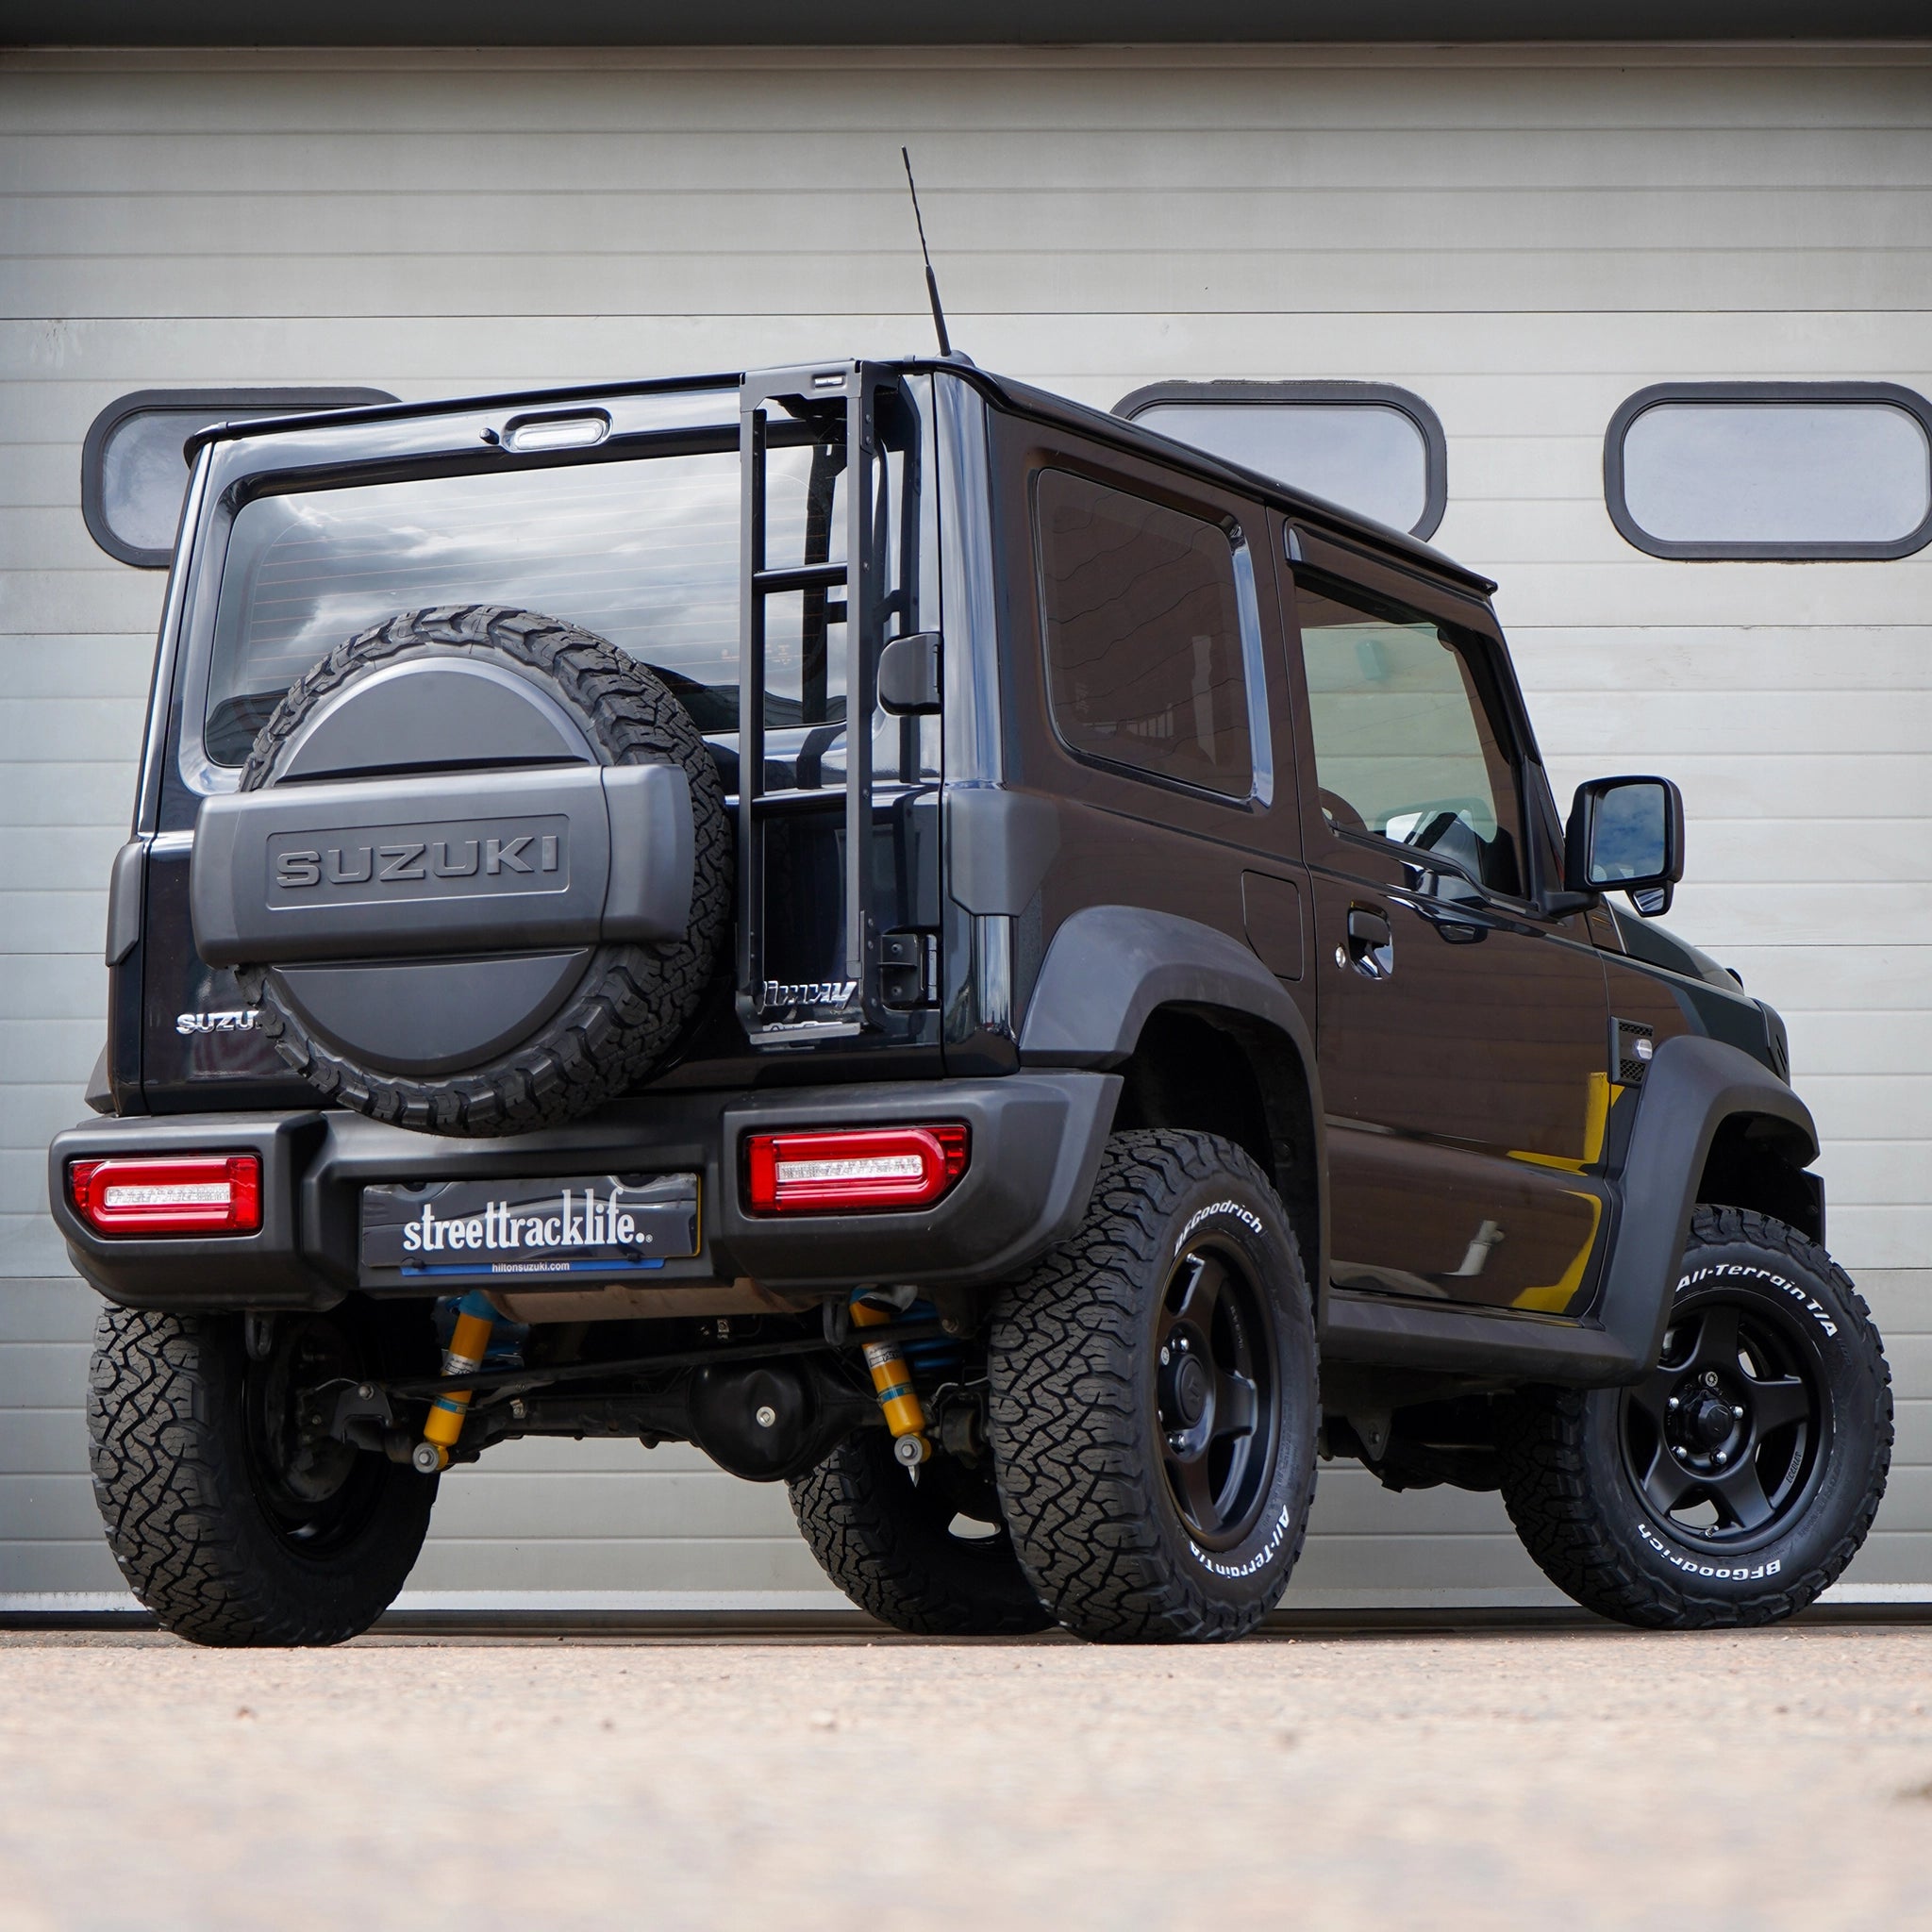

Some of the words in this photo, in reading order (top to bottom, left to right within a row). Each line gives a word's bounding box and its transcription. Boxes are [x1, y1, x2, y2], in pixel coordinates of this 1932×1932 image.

[275, 835, 559, 889] SUZUKI
[176, 1008, 262, 1035] SUZU
[491, 1259, 571, 1274] hiltonsuzuki.com
[1674, 1263, 1807, 1301] All-Terrain
[1215, 1504, 1291, 1579] All-Terrain
[1638, 1523, 1782, 1582] BFGoodrich
